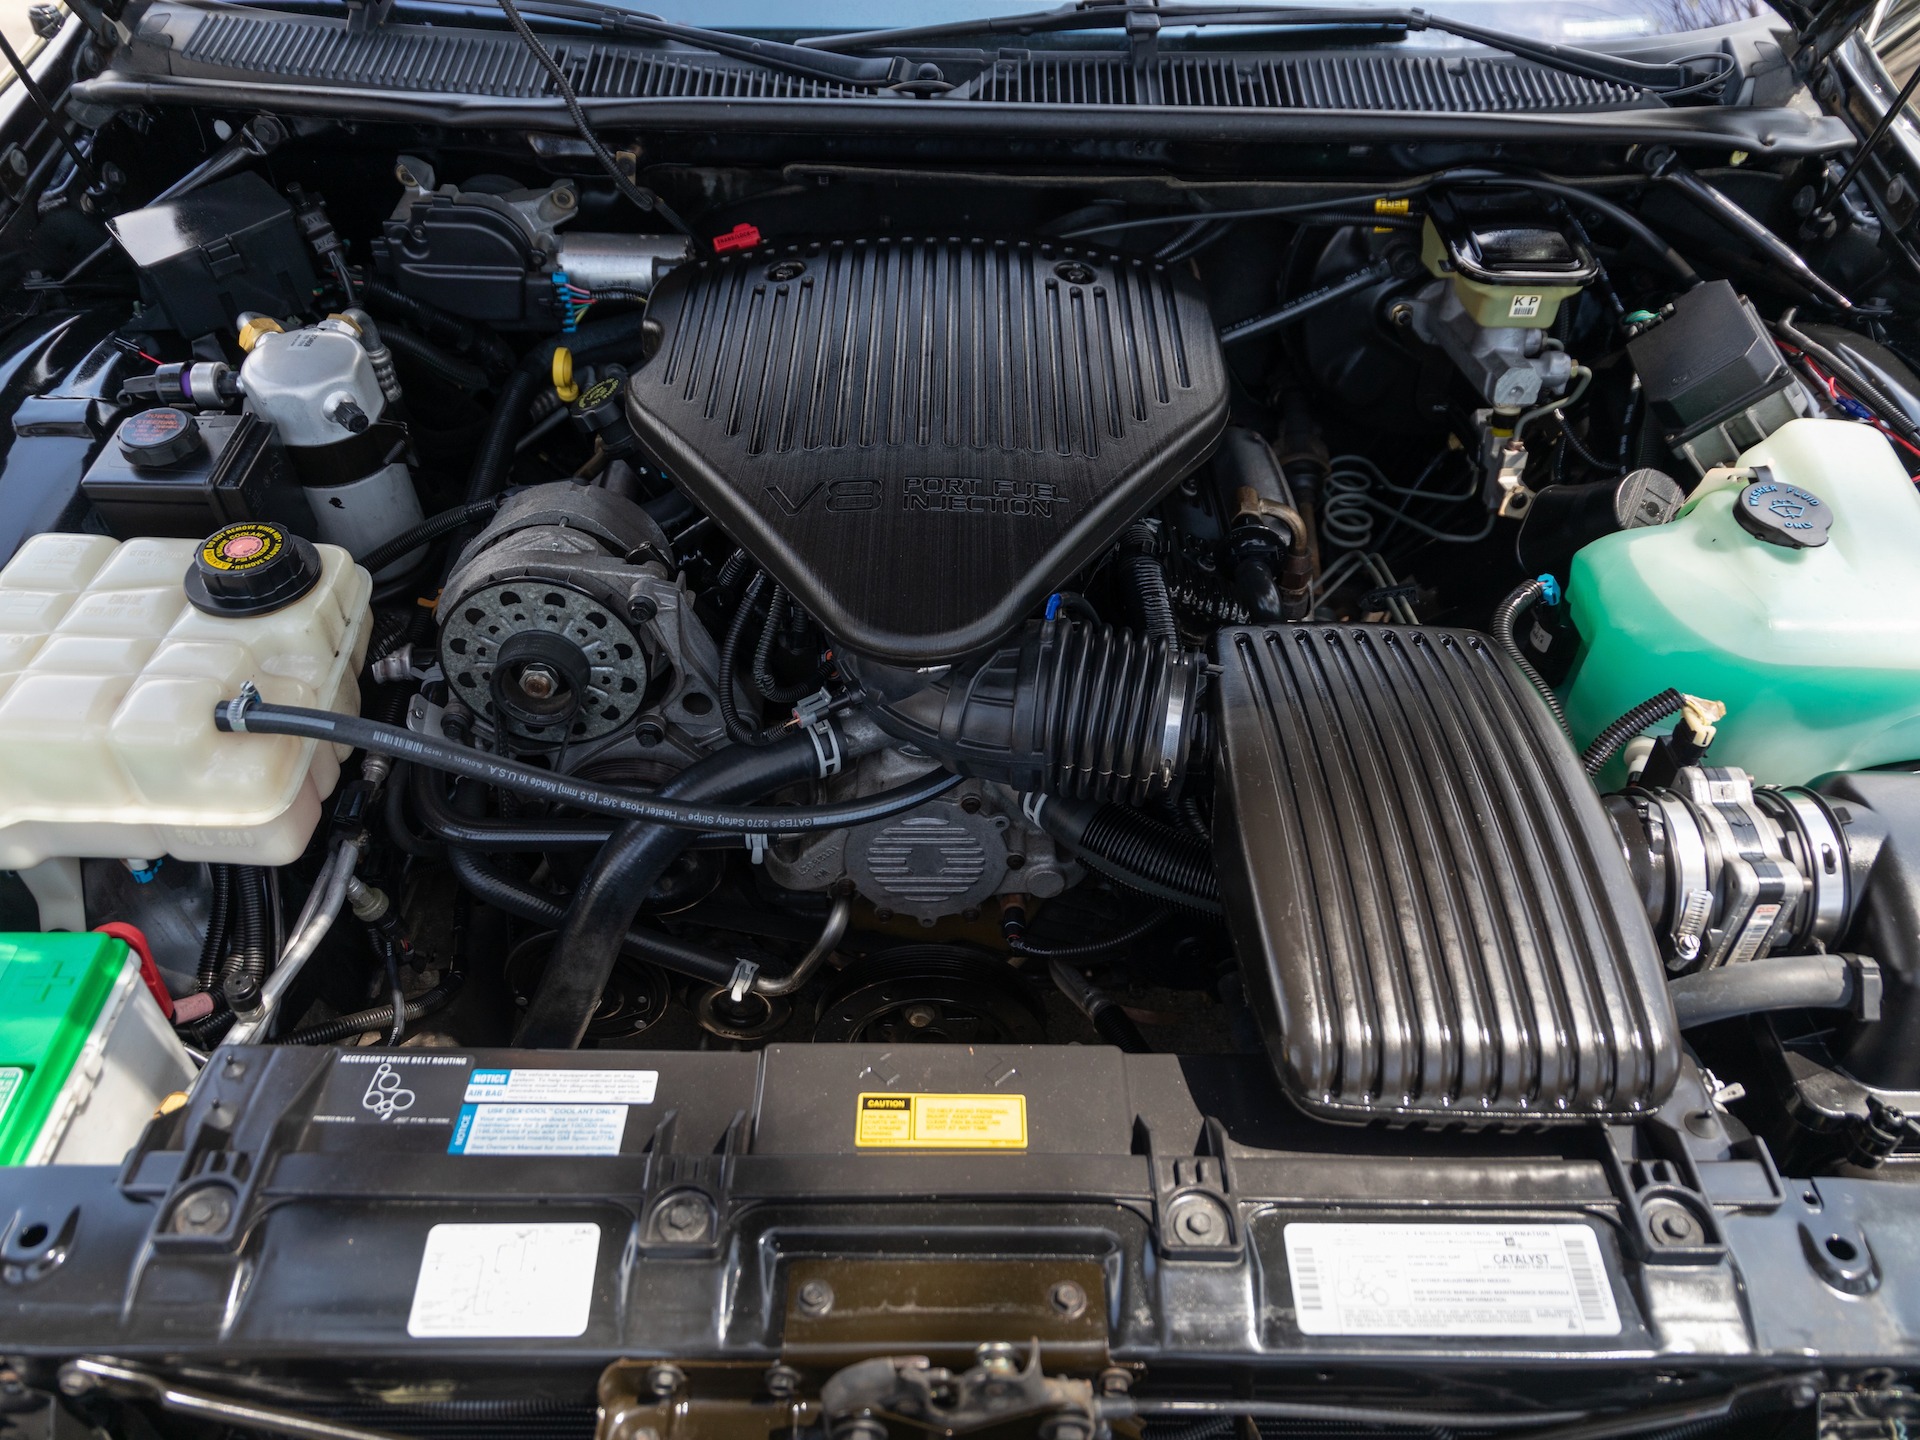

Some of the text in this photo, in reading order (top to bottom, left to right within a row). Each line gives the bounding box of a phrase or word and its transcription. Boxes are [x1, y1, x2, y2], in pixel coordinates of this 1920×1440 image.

[1514, 296, 1539, 306] K P
[902, 476, 1070, 503] PORT FUEL
[1749, 484, 1820, 506] WASHER FLUID
[763, 476, 883, 517] V8
[902, 493, 1053, 518] INJECTION
[226, 525, 257, 535] REMOVE
[1785, 521, 1814, 529] ONLY
[229, 532, 266, 540] COOLANT
[518, 773, 529, 785] in
[530, 777, 557, 793] Made
[557, 783, 579, 797] mm]
[600, 796, 618, 808] 3/8"
[620, 800, 645, 814] Hose
[645, 806, 678, 820] Heater
[716, 814, 745, 827] Safety
[747, 816, 770, 828] 3270
[340, 1055, 468, 1066] ACCESSORY DRIVE BELT ROUTING
[473, 1073, 507, 1084] NOTICE
[468, 1089, 504, 1097] AIR BAG
[867, 1099, 906, 1109] CAUTION
[454, 1114, 472, 1146] NOTICE
[1493, 1253, 1550, 1265] CATALYST
